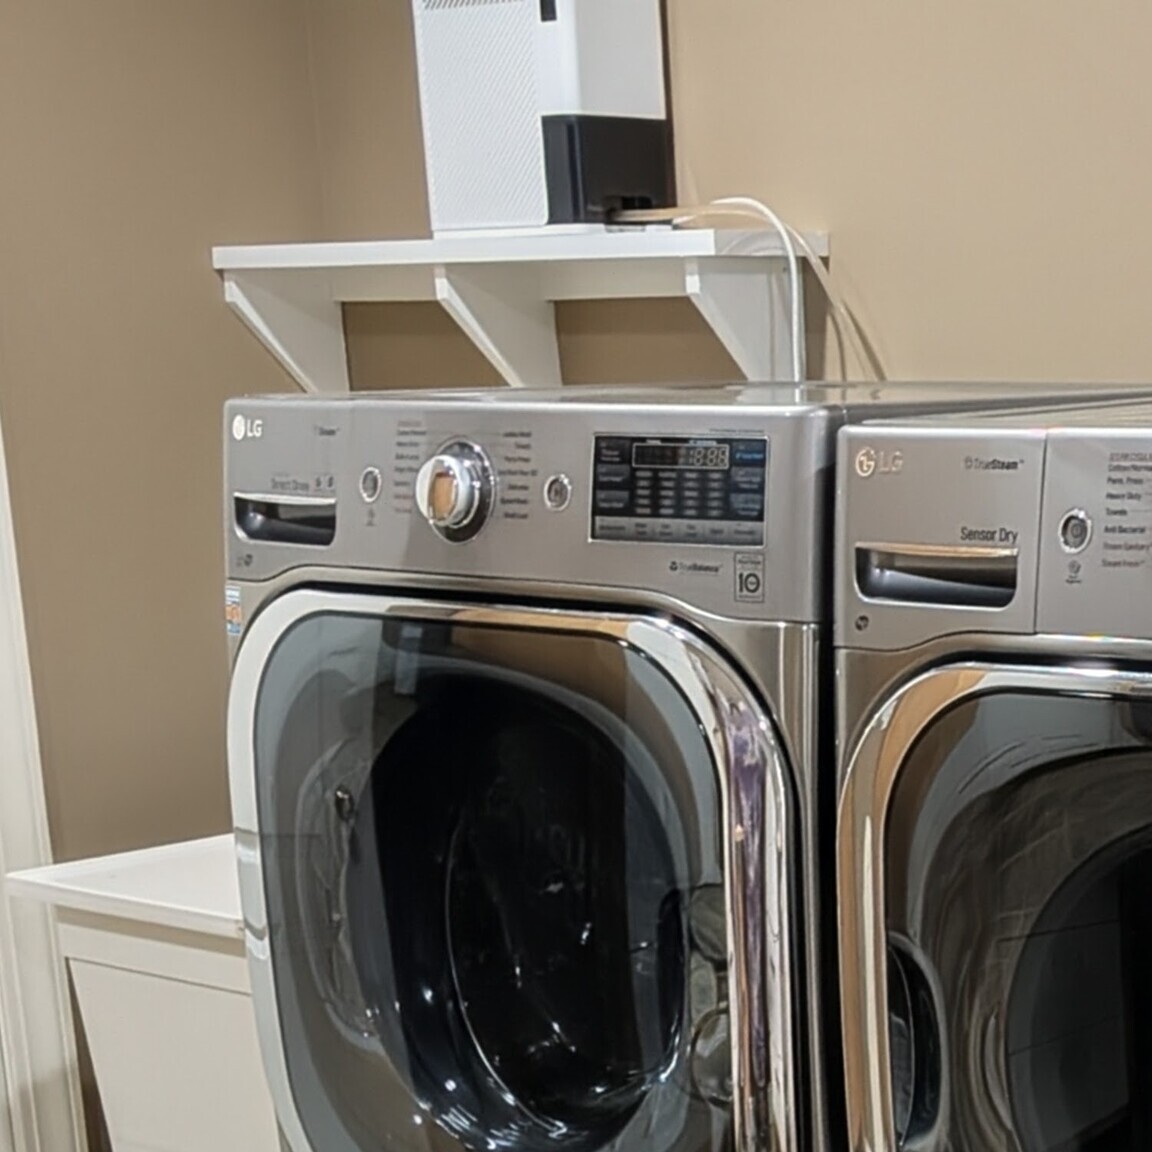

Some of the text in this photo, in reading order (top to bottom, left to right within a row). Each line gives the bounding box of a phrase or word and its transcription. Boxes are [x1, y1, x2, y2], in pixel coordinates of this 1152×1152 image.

[247, 418, 263, 437] LG
[880, 450, 904, 472] LG
[960, 526, 1019, 545] Sensor Dry
